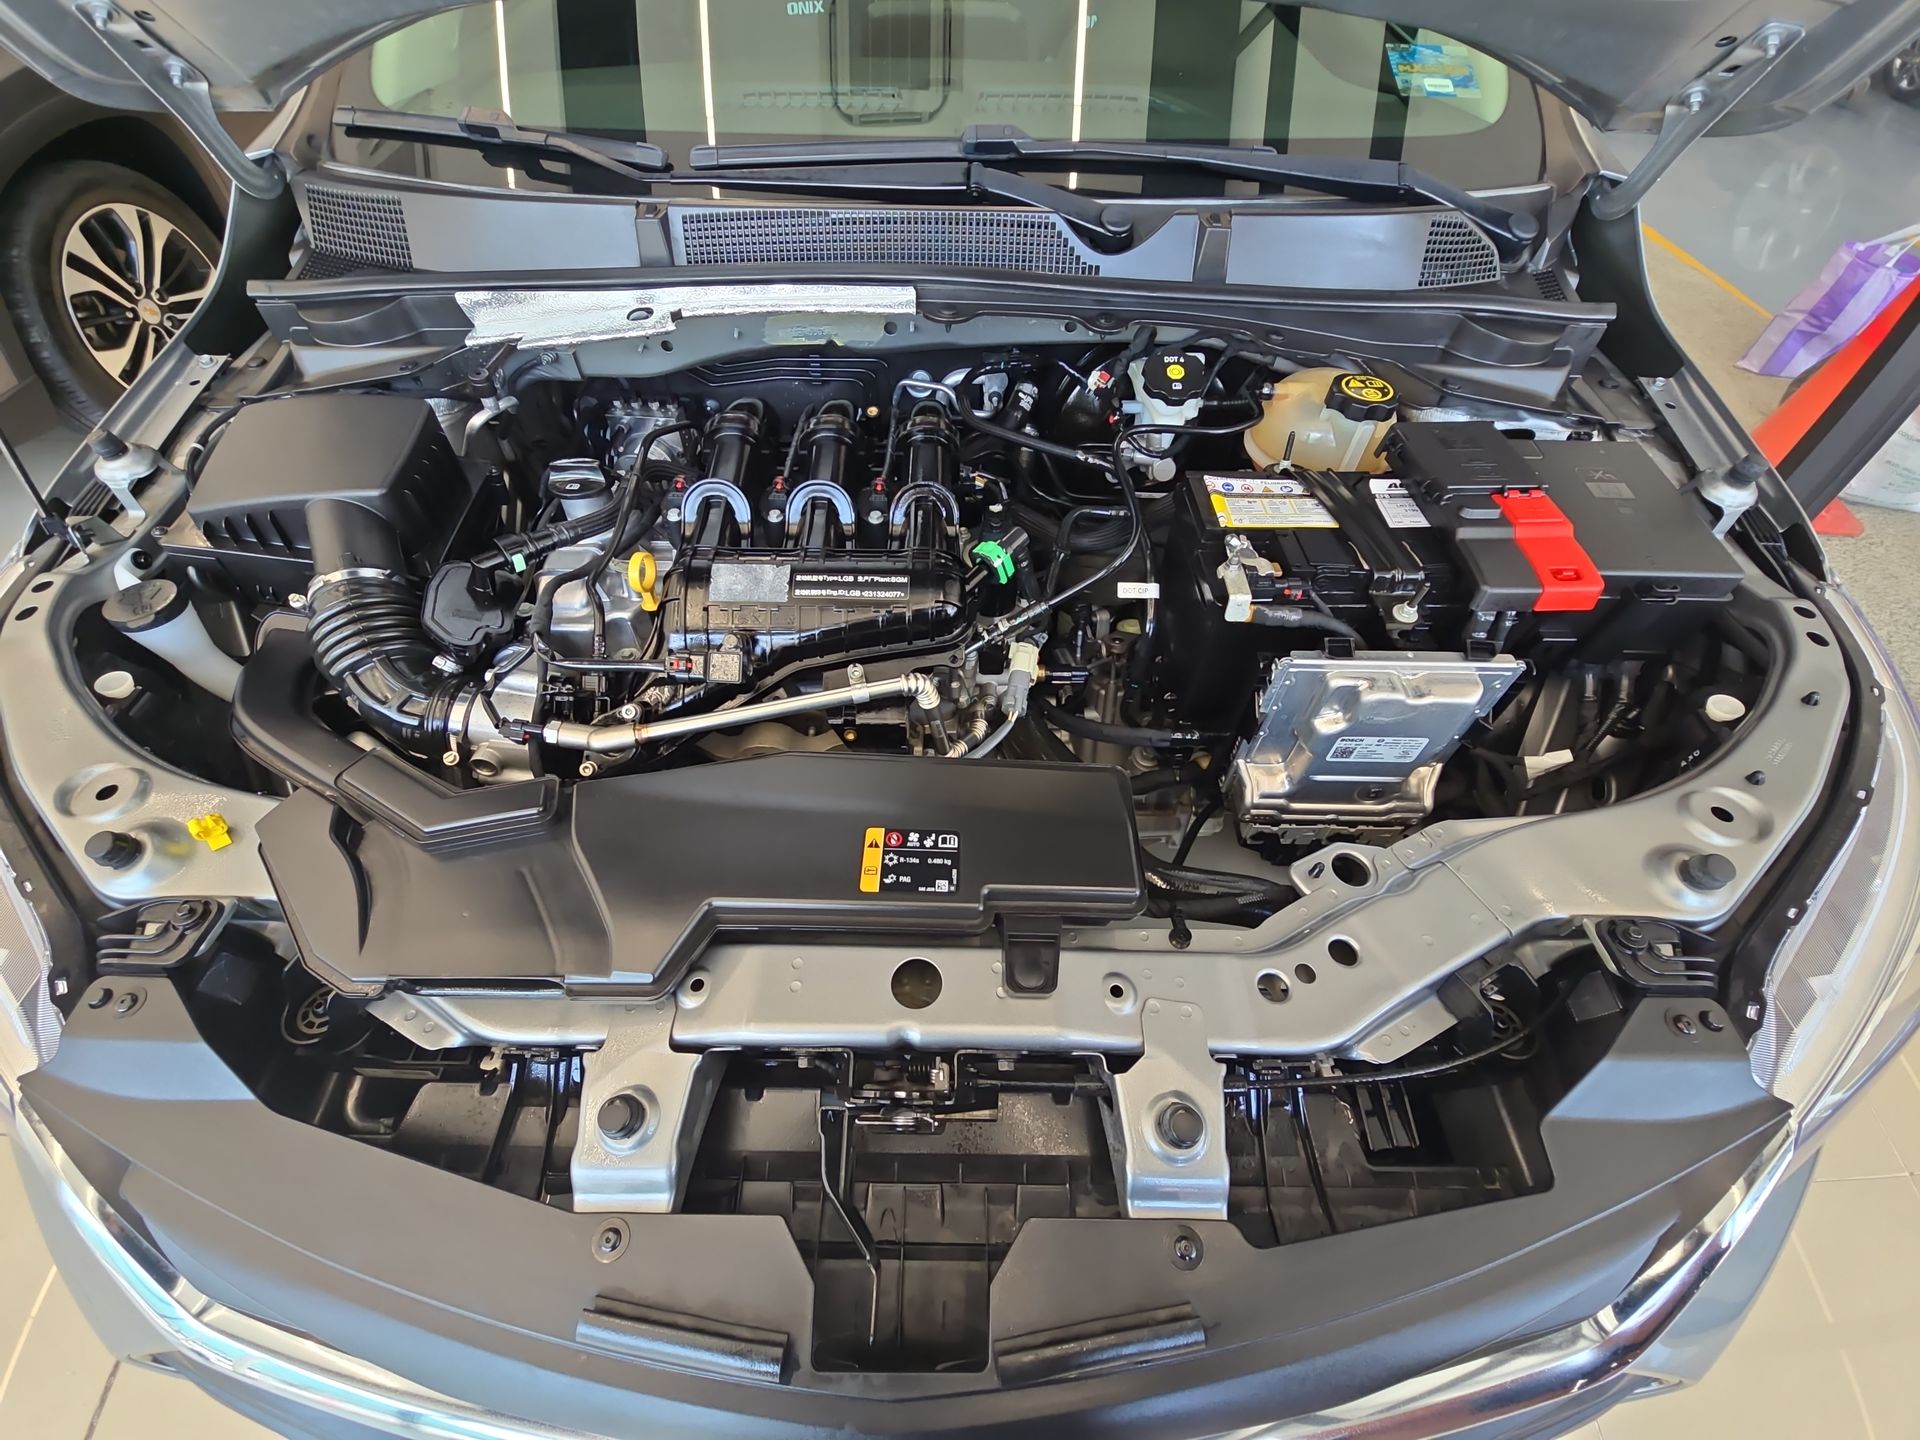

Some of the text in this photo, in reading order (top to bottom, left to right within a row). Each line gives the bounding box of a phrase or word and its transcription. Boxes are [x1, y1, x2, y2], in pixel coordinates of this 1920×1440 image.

[787, 0, 824, 15] ONIX
[943, 858, 952, 866] kg
[899, 875, 911, 883] PAG
